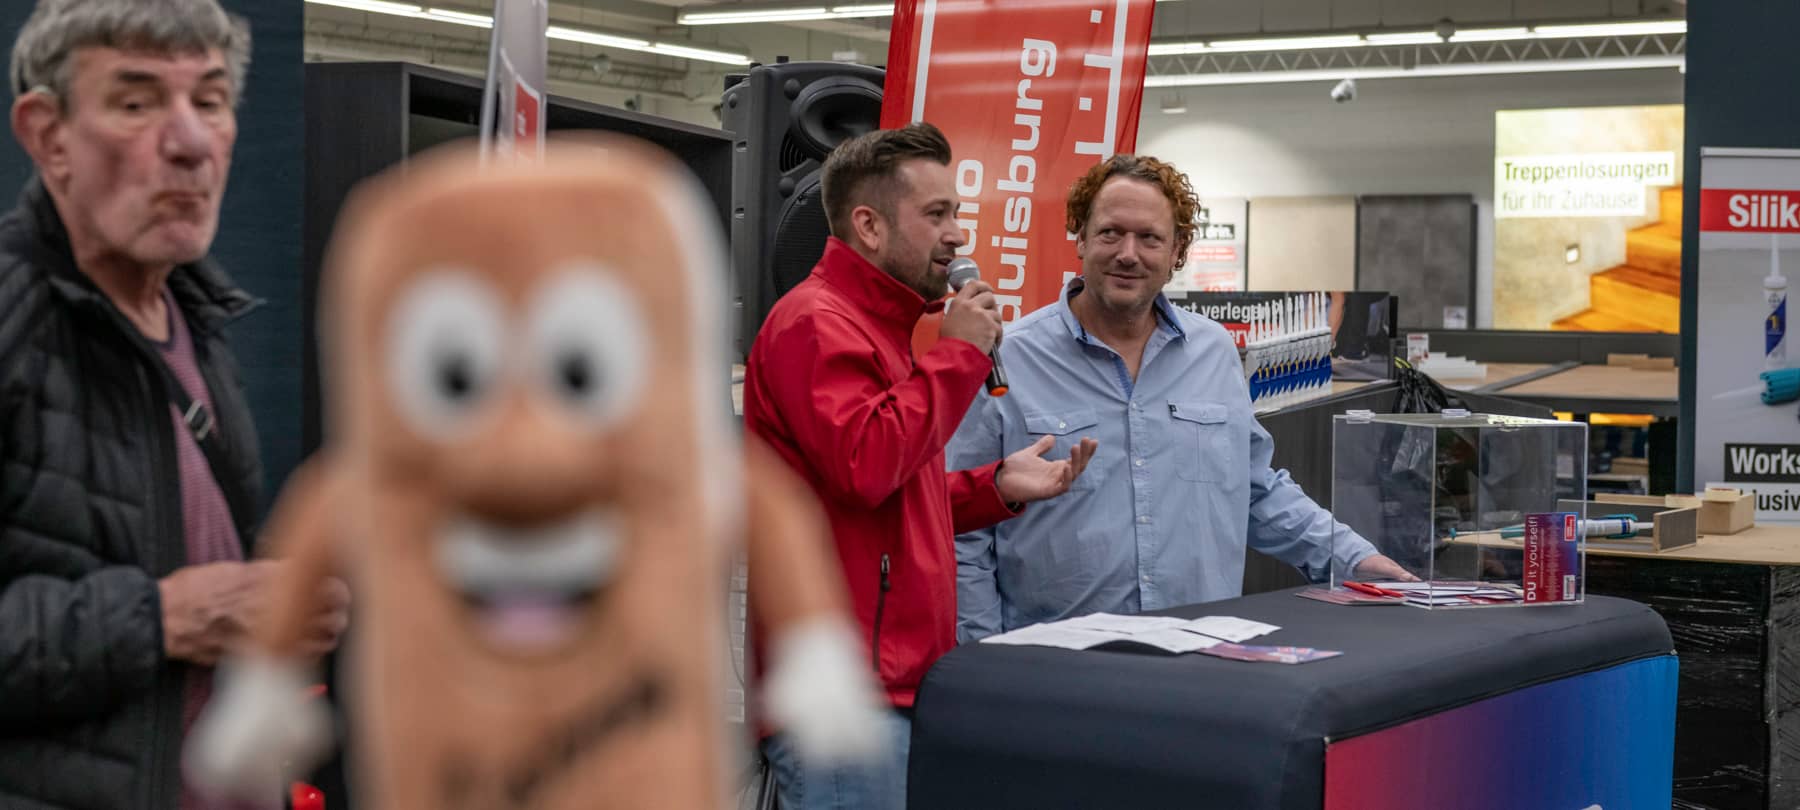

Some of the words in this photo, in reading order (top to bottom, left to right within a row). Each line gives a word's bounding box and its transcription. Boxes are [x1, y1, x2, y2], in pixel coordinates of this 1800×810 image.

[992, 37, 1057, 326] duisburg
[1502, 190, 1525, 210] für
[1560, 188, 1639, 210] Zuhause
[1728, 194, 1800, 228] Silik
[1527, 516, 1539, 568] yourself!
[1526, 582, 1536, 601] DU
